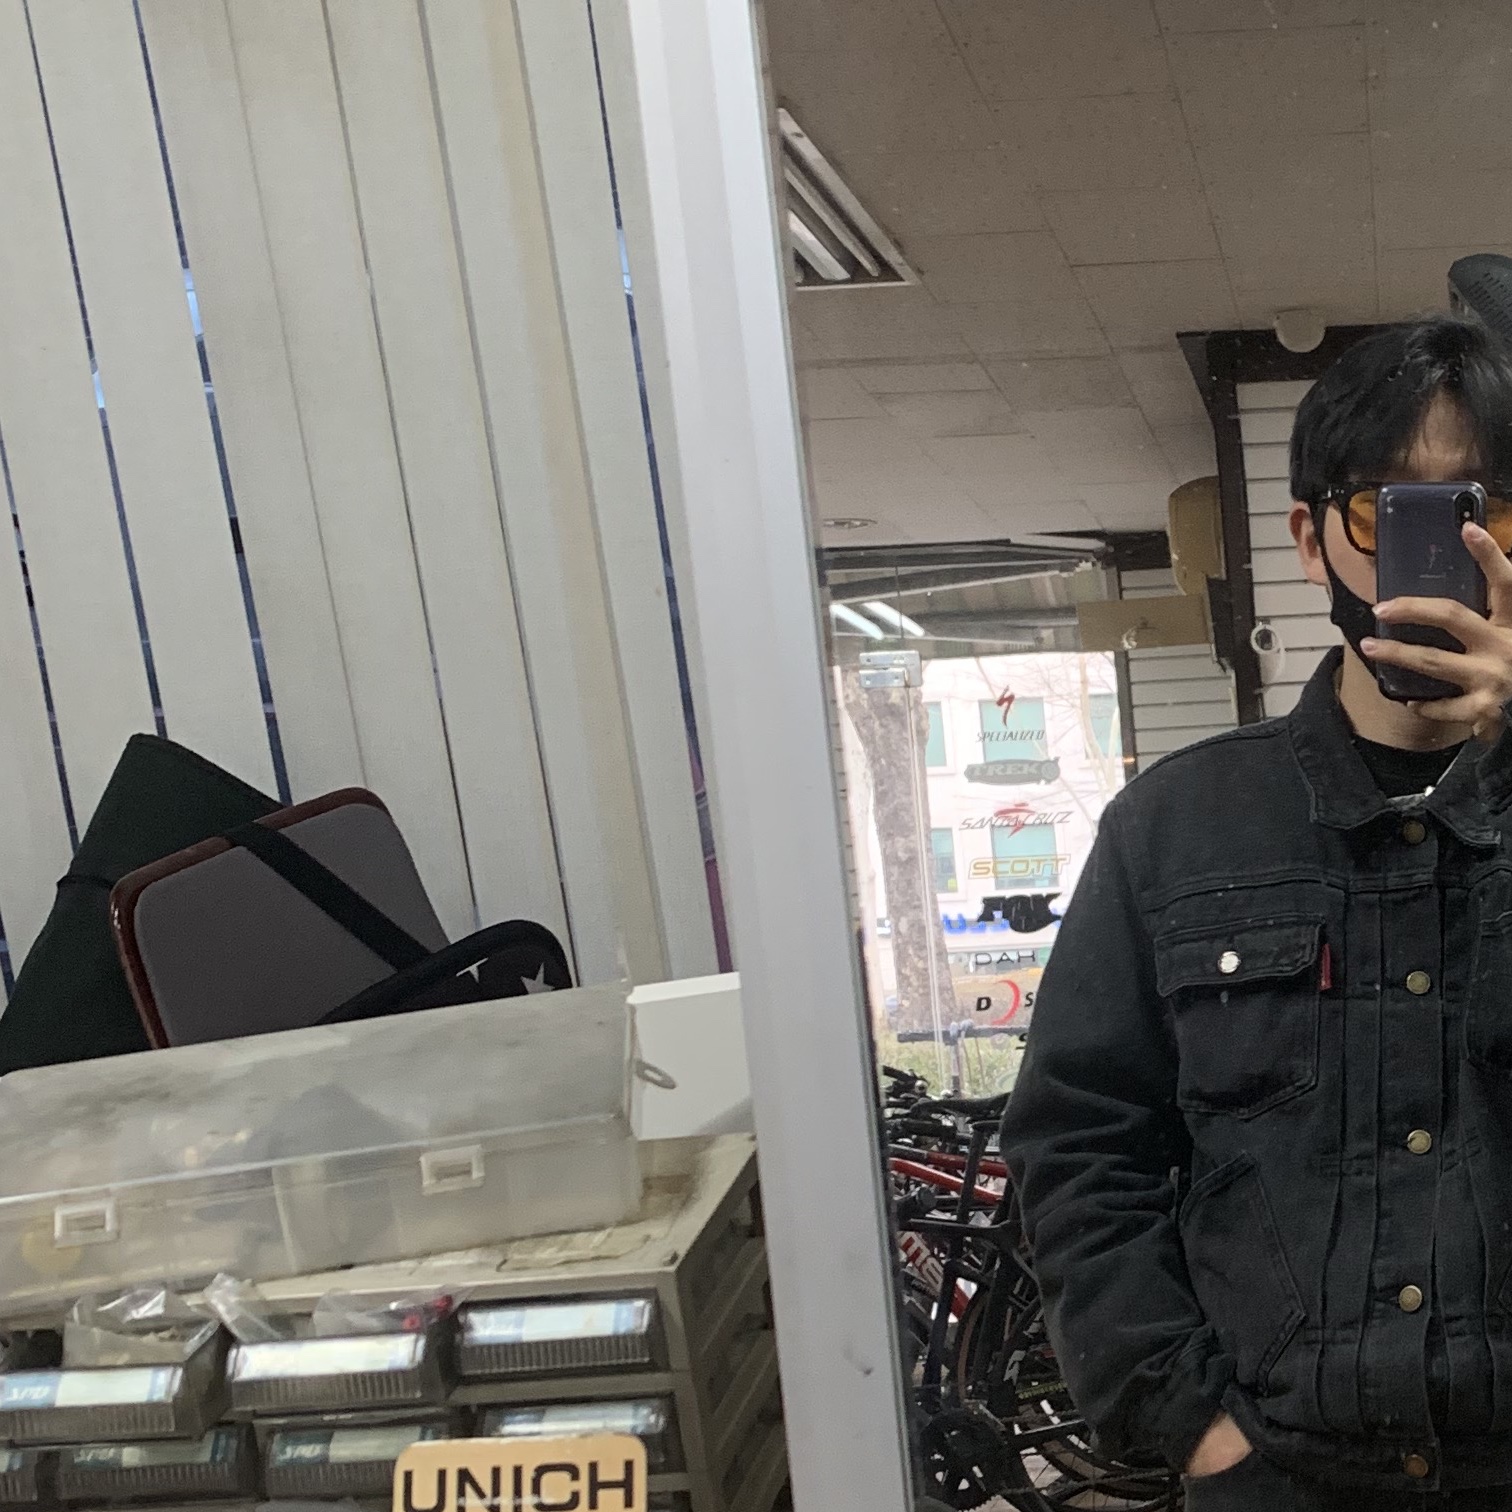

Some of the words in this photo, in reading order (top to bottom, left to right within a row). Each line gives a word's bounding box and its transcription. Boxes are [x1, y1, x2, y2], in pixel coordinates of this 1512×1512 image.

[976, 729, 1046, 743] SPECIALIZED
[972, 762, 1038, 777] TREK
[970, 857, 1068, 877] SCOTT
[974, 951, 1037, 966] DAH
